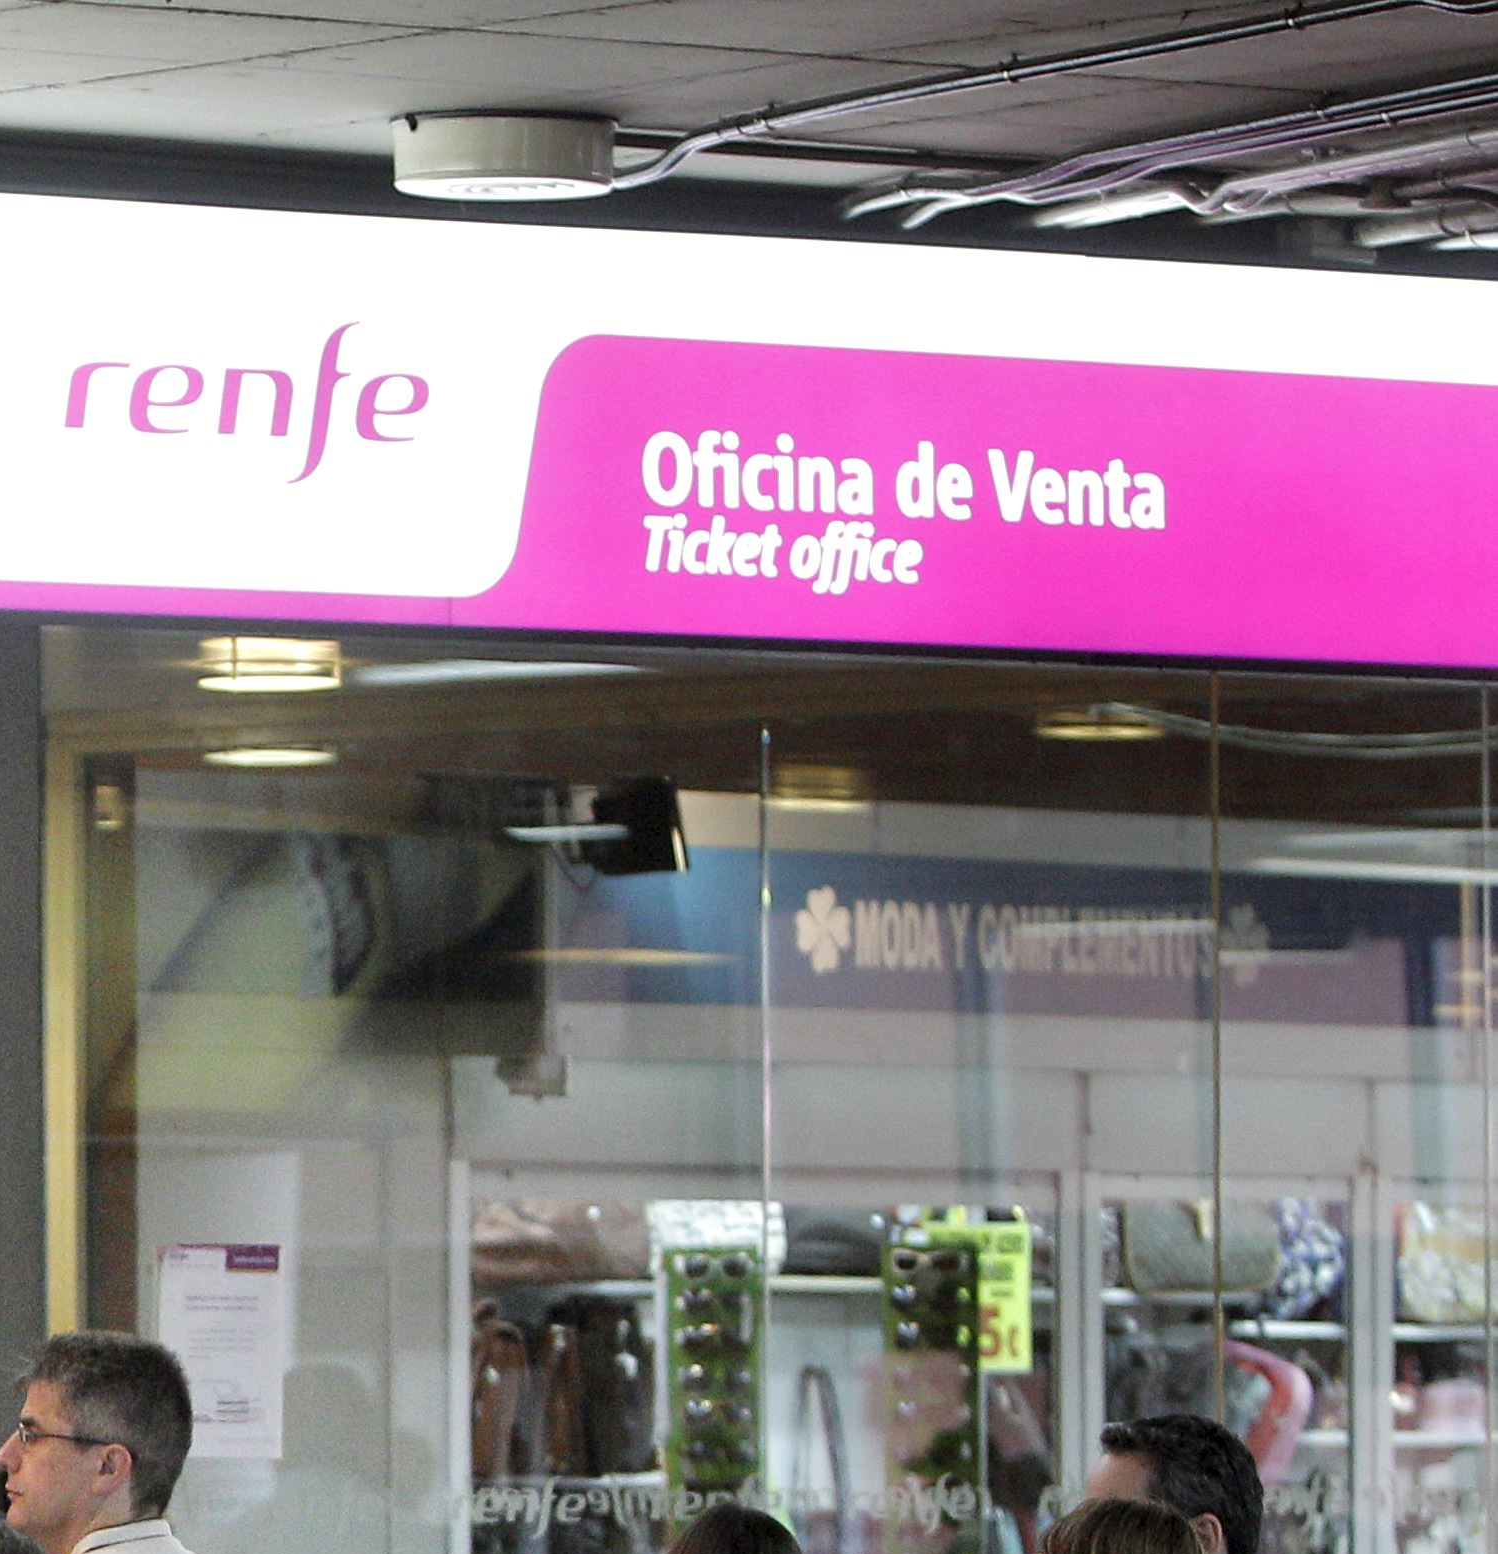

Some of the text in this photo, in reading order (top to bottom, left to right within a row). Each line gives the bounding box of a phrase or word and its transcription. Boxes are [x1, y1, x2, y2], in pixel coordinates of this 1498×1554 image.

[65, 322, 430, 483] renfe
[641, 430, 1166, 530] Oficina de Venta
[642, 514, 923, 595] Ticket office
[855, 899, 942, 969] MODA
